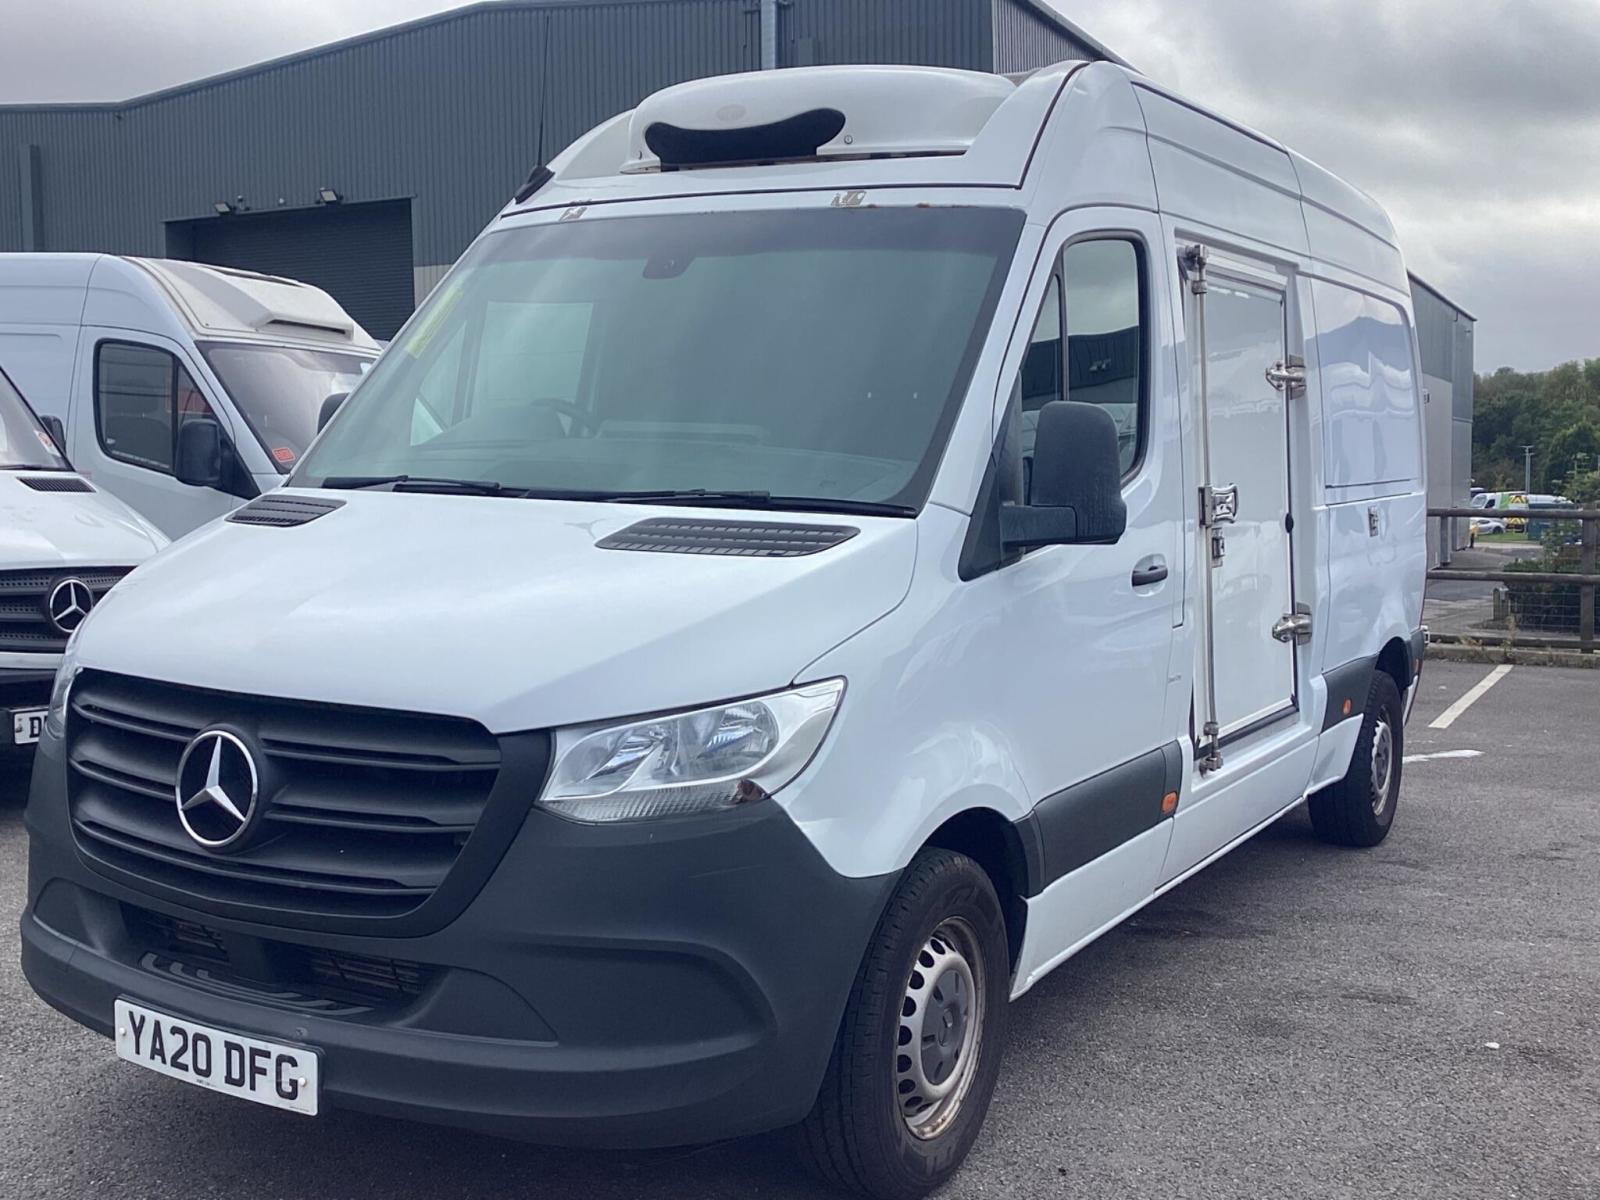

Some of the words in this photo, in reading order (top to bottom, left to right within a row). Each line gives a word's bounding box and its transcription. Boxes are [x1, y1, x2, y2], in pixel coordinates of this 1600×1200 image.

[29, 715, 48, 738] D
[128, 1010, 212, 1078] YA20
[224, 1040, 299, 1101] DFG
